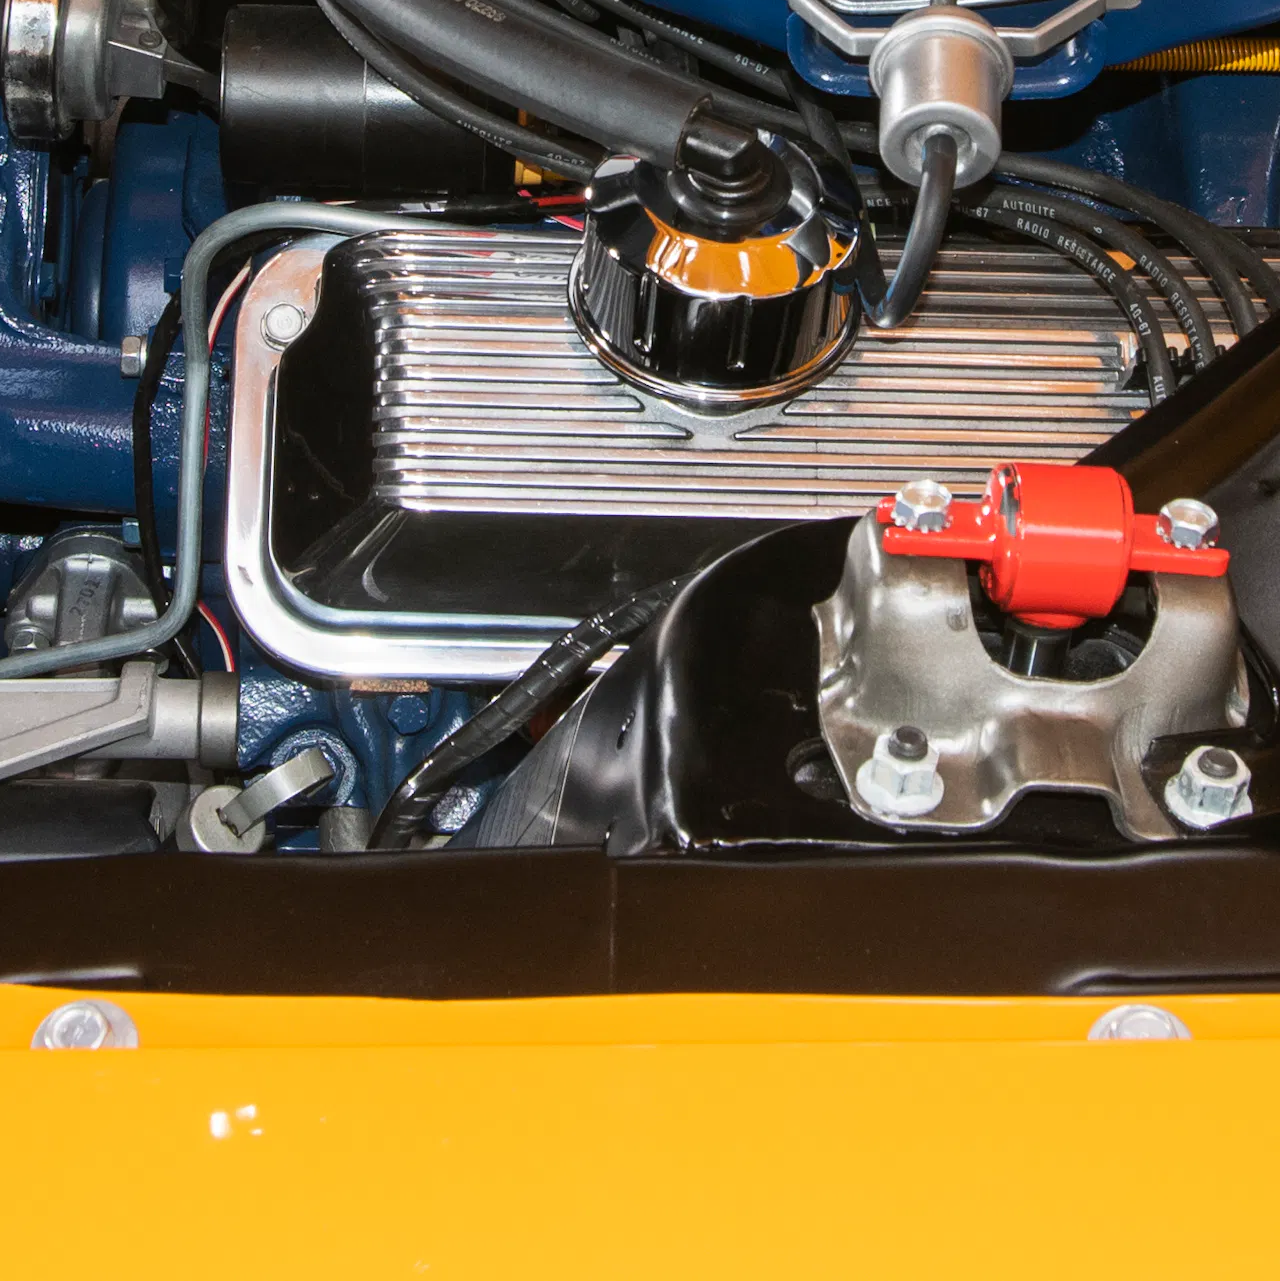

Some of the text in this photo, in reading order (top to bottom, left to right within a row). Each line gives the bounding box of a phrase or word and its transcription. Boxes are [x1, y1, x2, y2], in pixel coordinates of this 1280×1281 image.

[1016, 218, 1050, 239] RADIO
[1002, 199, 1056, 218] AUTOLITE
[1139, 254, 1168, 288] RADIO
[1171, 291, 1205, 370] RESISTANCE
